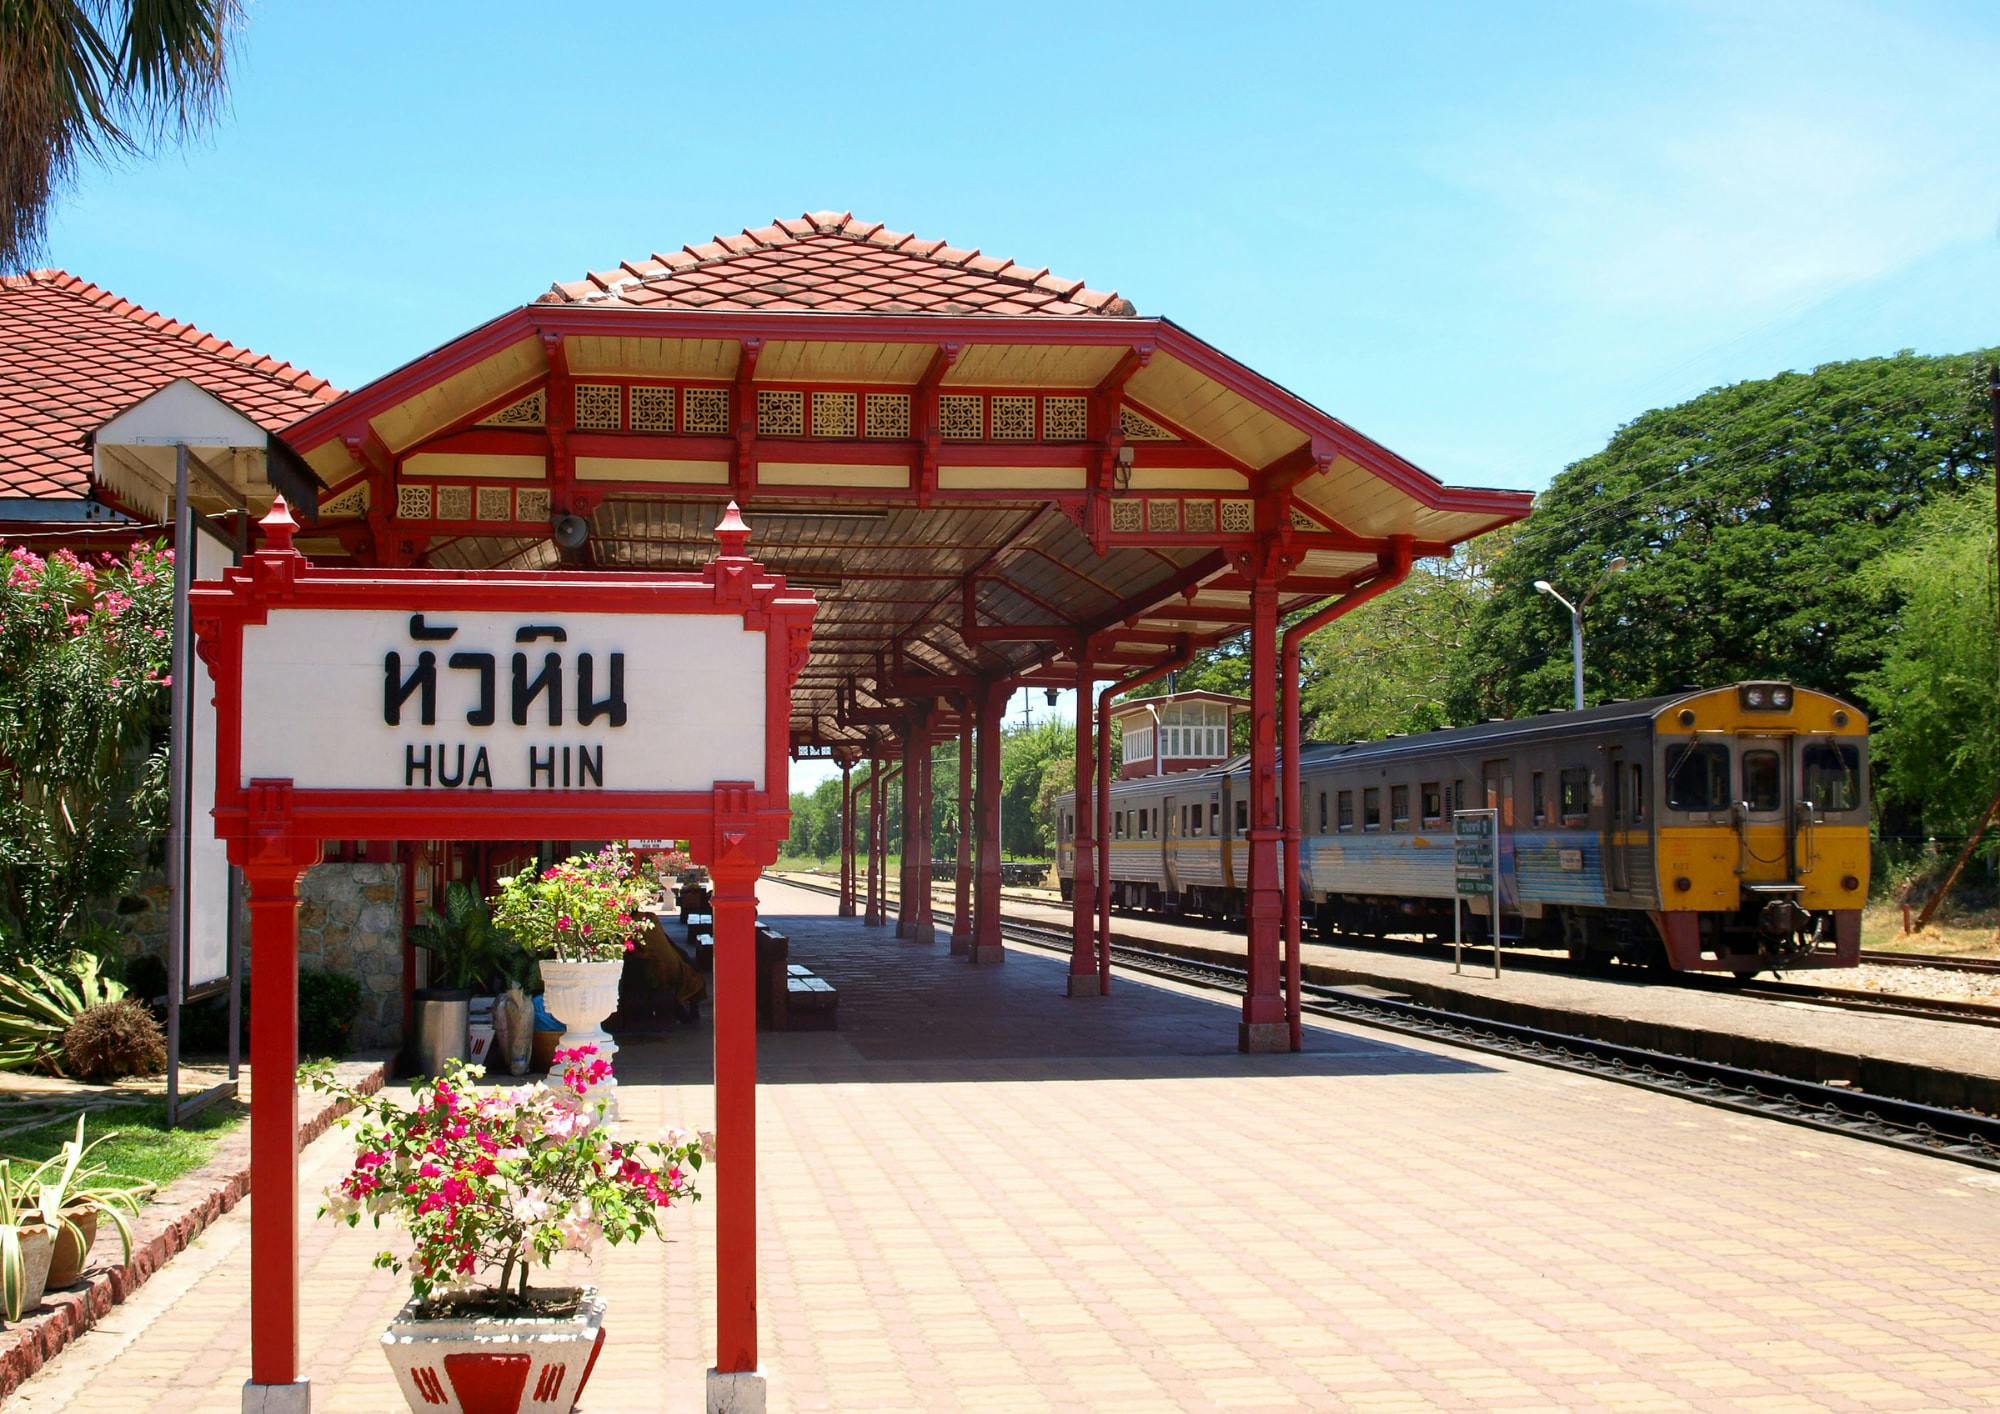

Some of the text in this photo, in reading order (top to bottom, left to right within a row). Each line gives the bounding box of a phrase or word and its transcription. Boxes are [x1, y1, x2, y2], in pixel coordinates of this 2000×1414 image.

[384, 614, 627, 727] หัวหิน
[405, 744, 604, 788] HUA HIN
